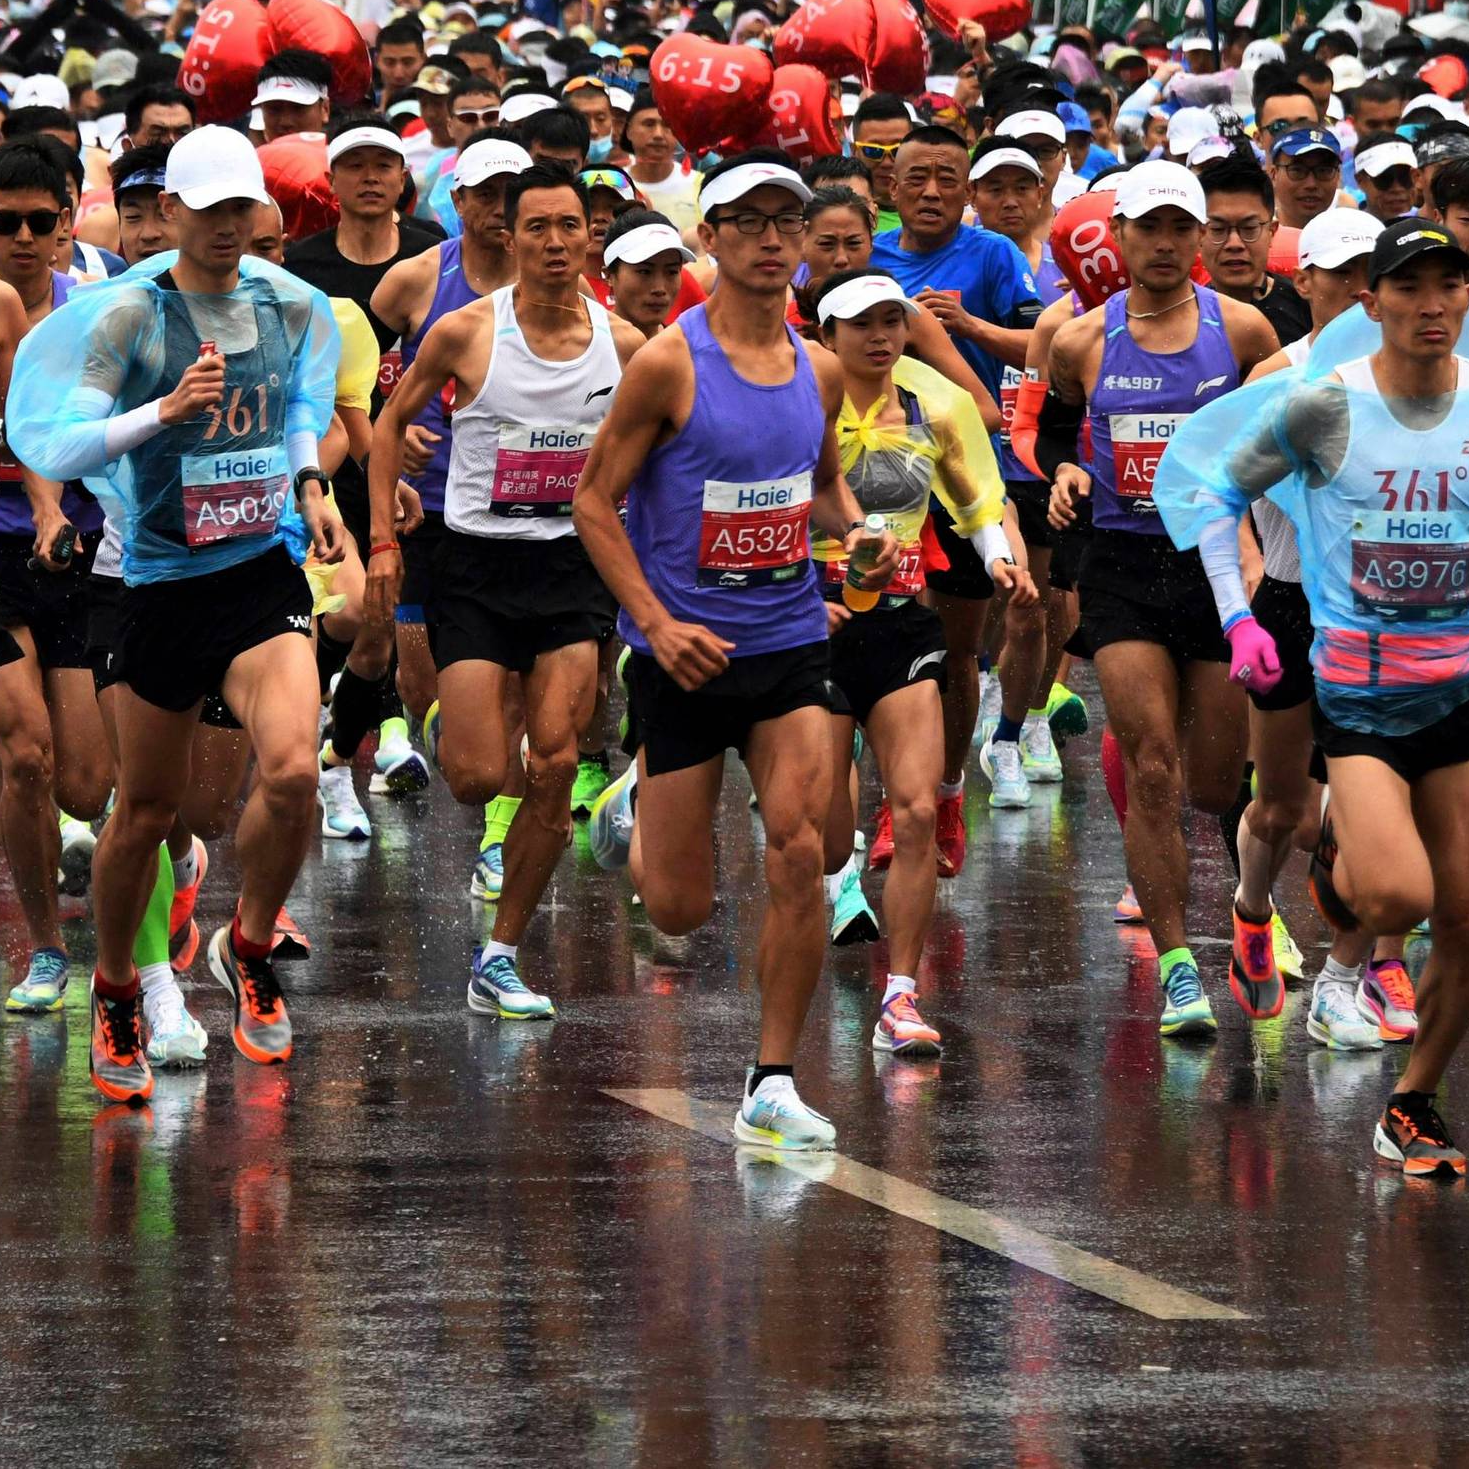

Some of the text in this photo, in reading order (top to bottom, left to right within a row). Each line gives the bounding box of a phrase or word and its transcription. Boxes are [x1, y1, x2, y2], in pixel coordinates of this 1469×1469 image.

[183, 7, 235, 96] 6:15
[657, 50, 745, 95] 6:15
[769, 89, 813, 167] 6:1
[530, 430, 585, 448] Haier
[215, 456, 271, 479] Haier
[545, 473, 582, 489] PAC
[196, 492, 286, 529] A5029
[738, 486, 793, 508] Haier
[711, 520, 802, 555] A5321
[1387, 518, 1452, 539] Haier
[1361, 560, 1467, 588] A3976
